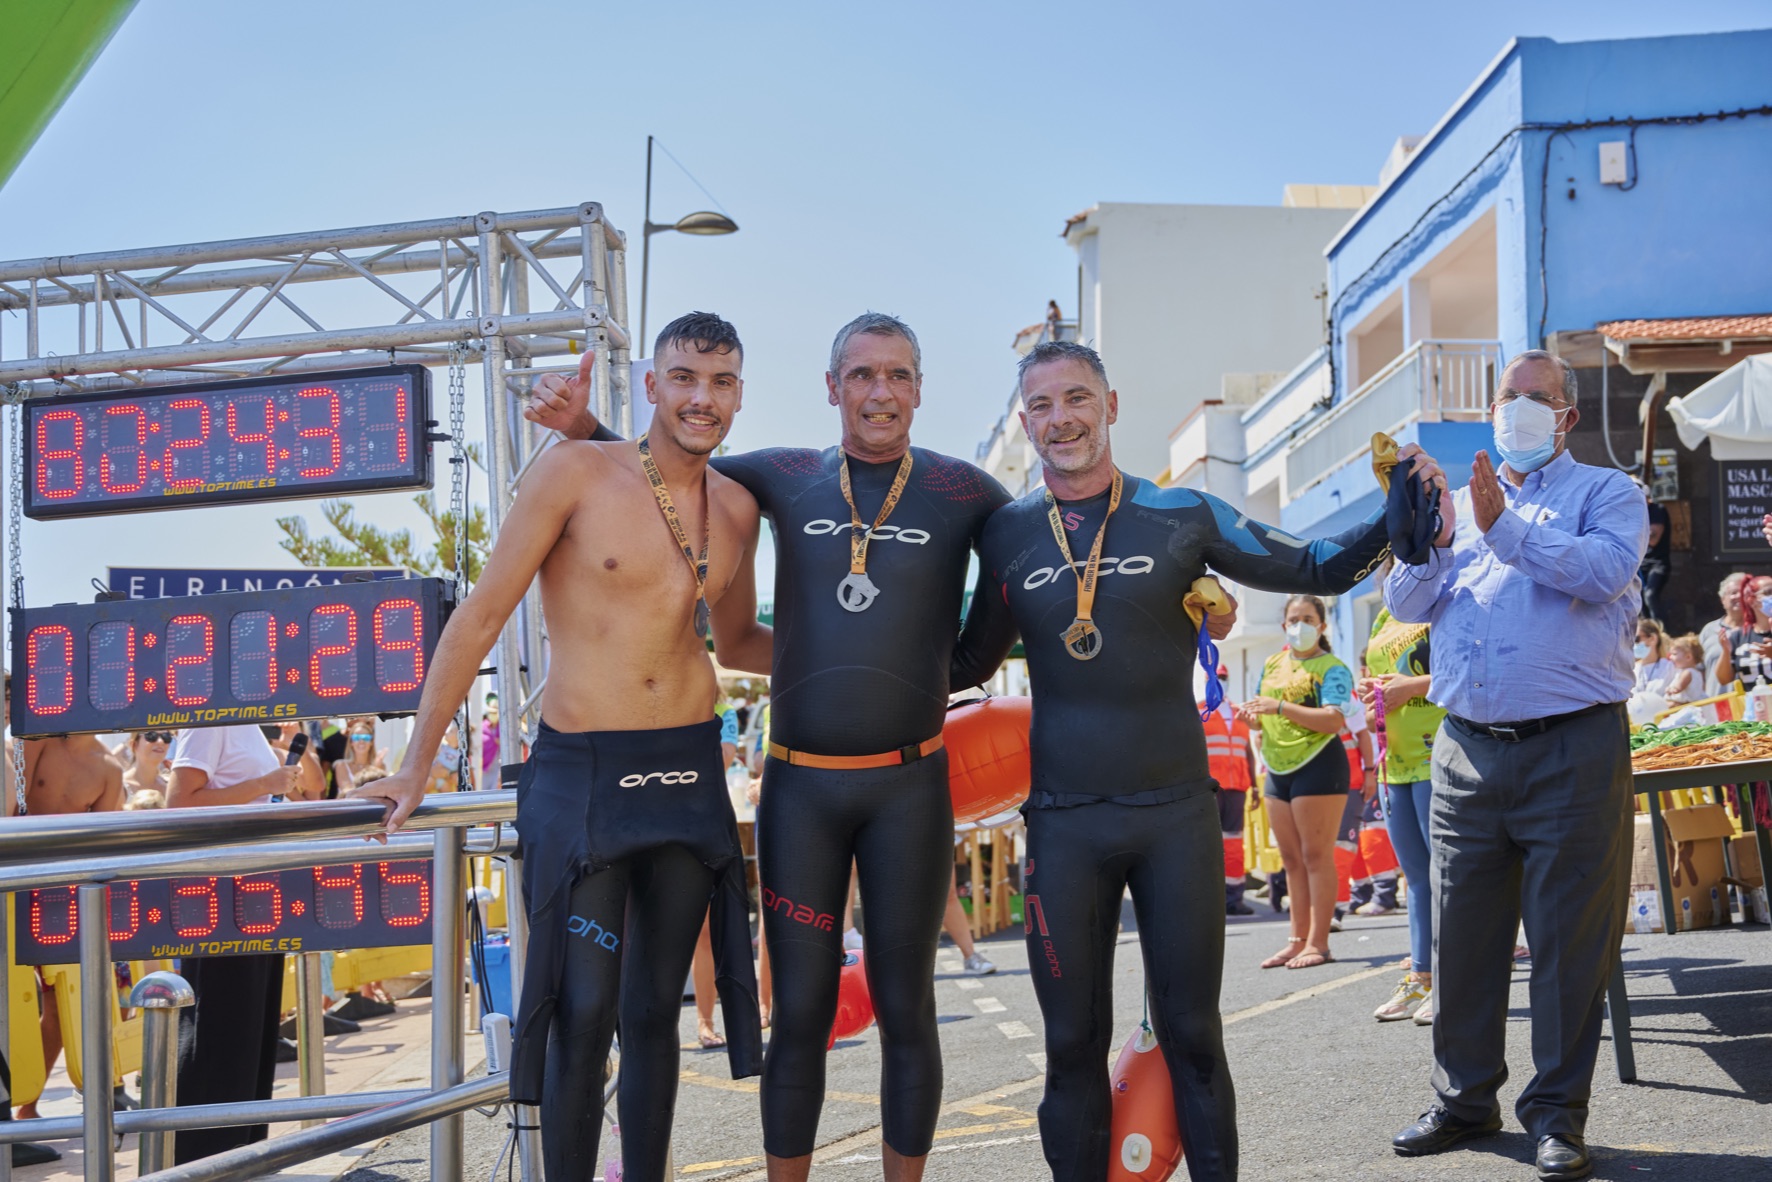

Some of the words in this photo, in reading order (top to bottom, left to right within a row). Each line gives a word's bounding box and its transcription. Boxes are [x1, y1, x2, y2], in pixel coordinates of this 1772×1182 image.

[1727, 469, 1758, 482] USA
[1728, 503, 1750, 515] Por
[1752, 504, 1765, 514] tu
[803, 519, 931, 545] orca
[1738, 527, 1749, 538] la
[1023, 555, 1155, 590] orca
[1083, 569, 1096, 592] FINISHER
[26, 598, 425, 716] 01:21:29
[618, 770, 699, 788] orca
